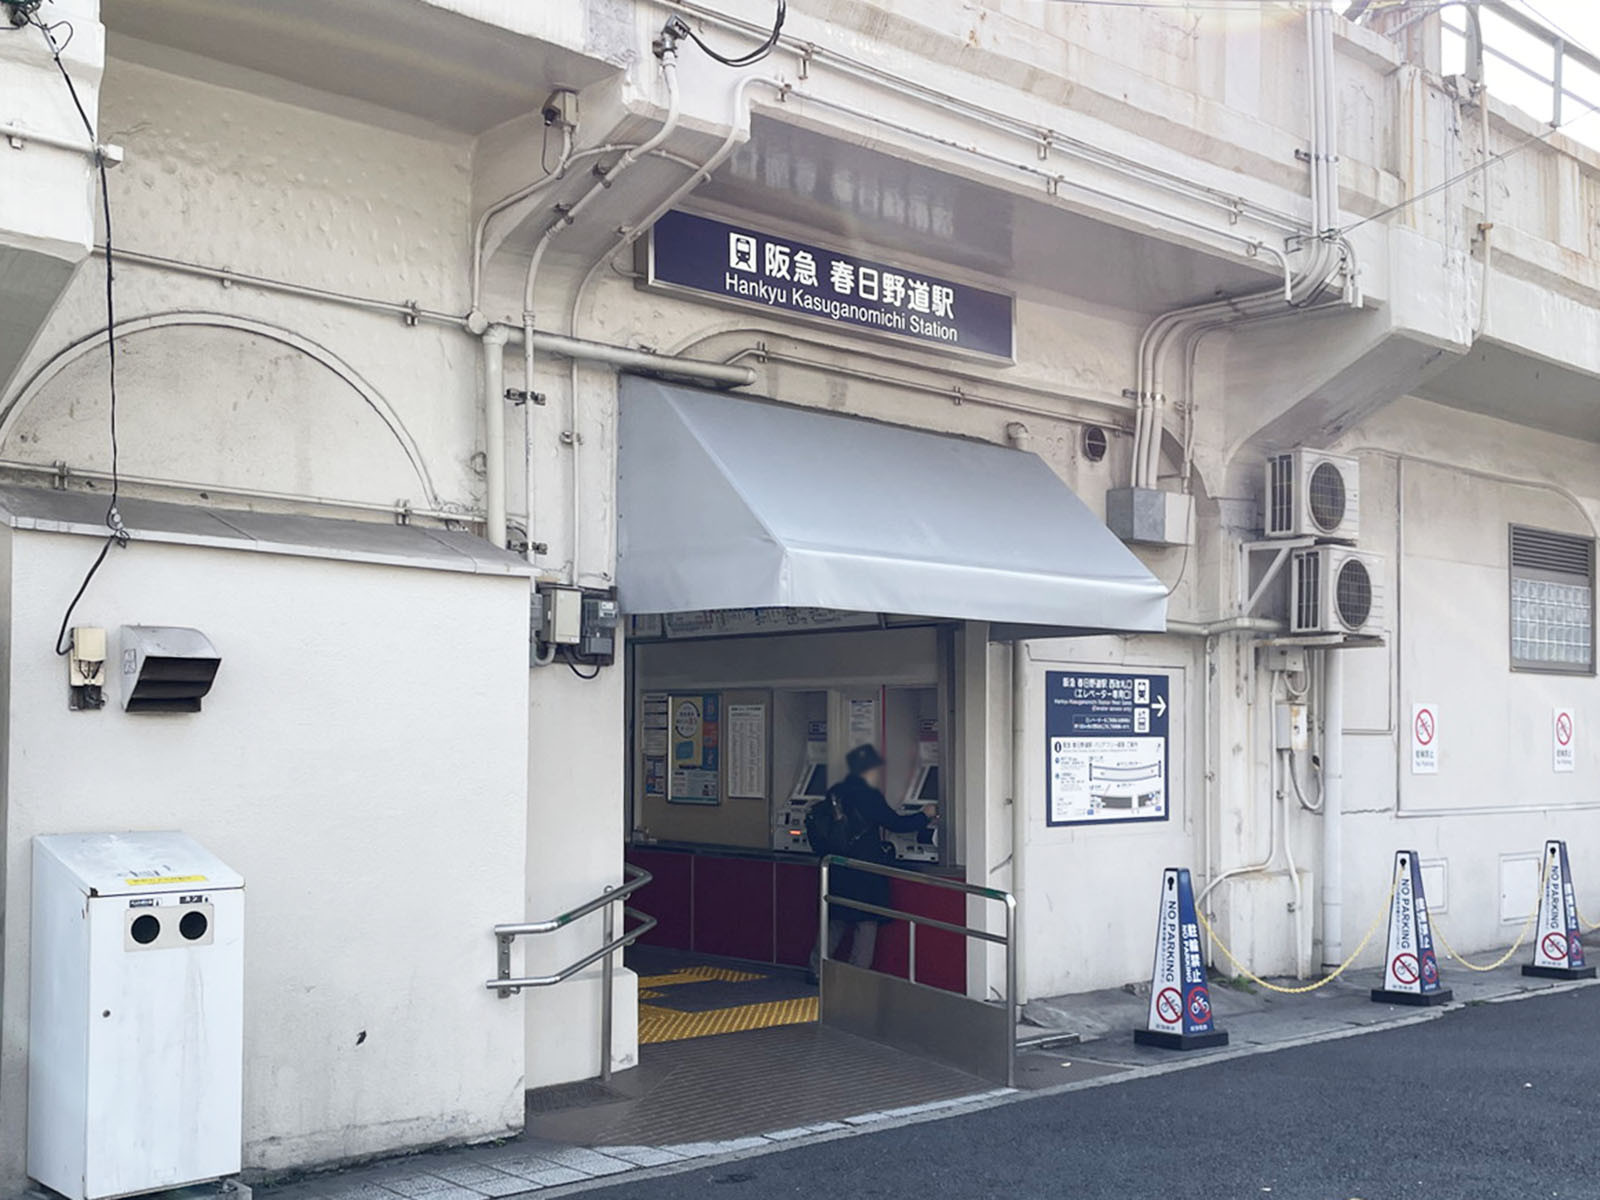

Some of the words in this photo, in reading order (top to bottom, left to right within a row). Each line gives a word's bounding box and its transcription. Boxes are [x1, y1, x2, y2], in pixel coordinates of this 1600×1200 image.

[725, 271, 787, 305] Hankyu
[792, 287, 906, 329] Kasuganomichi
[909, 314, 958, 341] Station
[765, 242, 818, 287] 阪急
[830, 260, 954, 319] 春日野道駅
[1167, 900, 1177, 920] NO
[1401, 878, 1410, 895] NO
[1401, 898, 1410, 949] PARKING
[1166, 923, 1176, 983] PARKING
